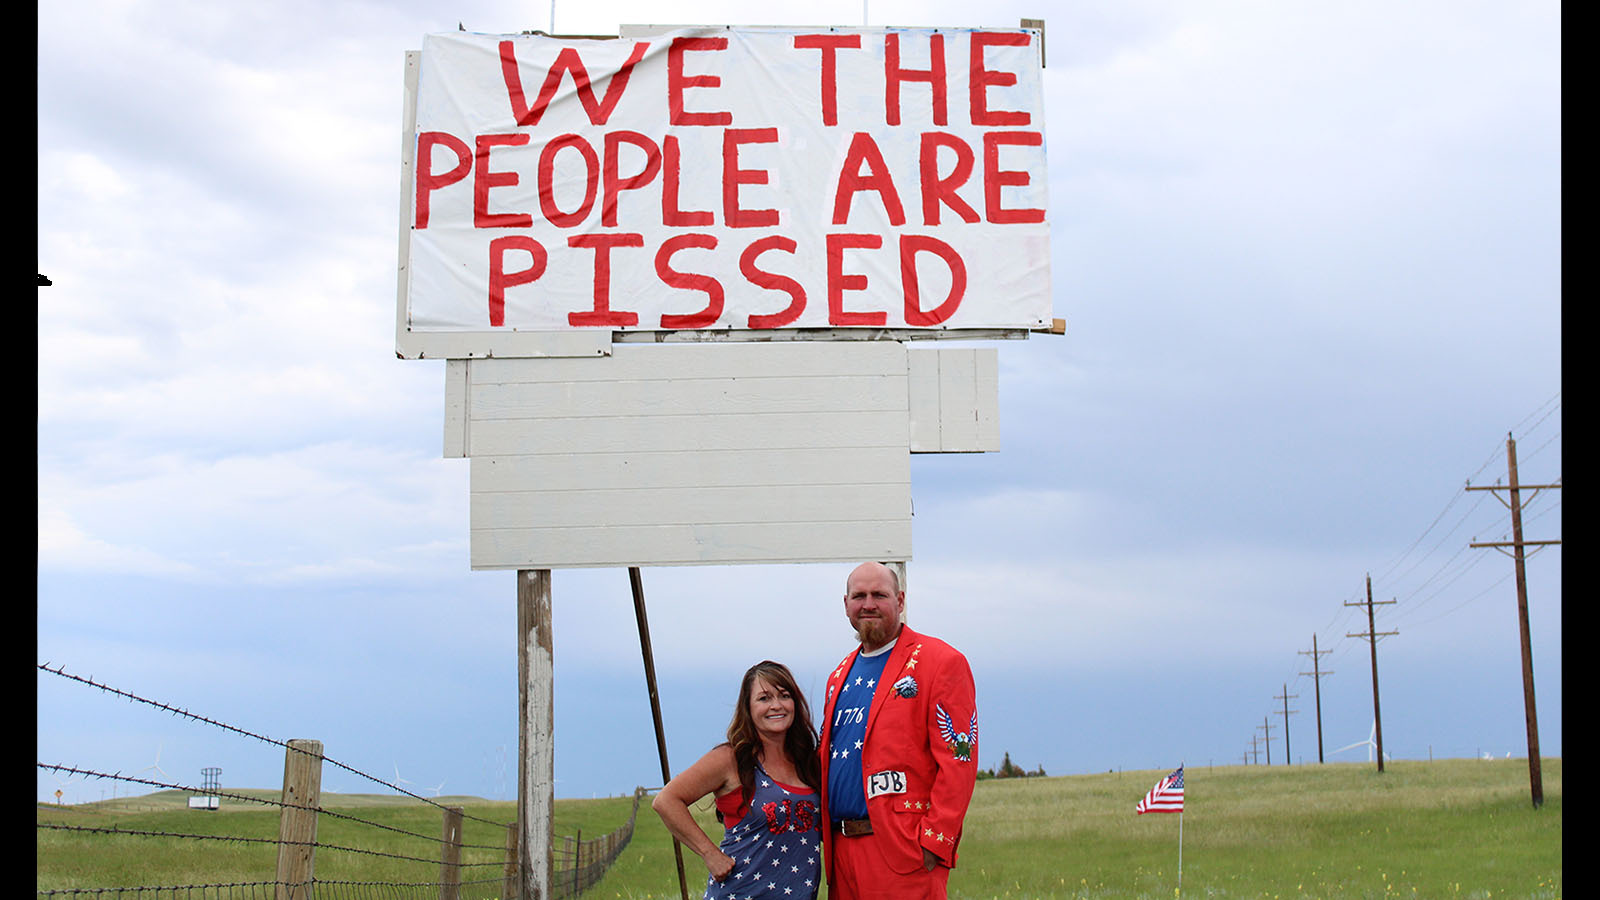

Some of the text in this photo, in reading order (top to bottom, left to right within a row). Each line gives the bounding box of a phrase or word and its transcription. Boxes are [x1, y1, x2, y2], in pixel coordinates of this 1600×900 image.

[499, 32, 1033, 128] WE THE
[415, 128, 1047, 231] PEOPLE ARE
[489, 233, 969, 331] PISSED
[834, 706, 866, 727] 1776
[870, 771, 904, 795] FJB
[761, 799, 821, 835] US
